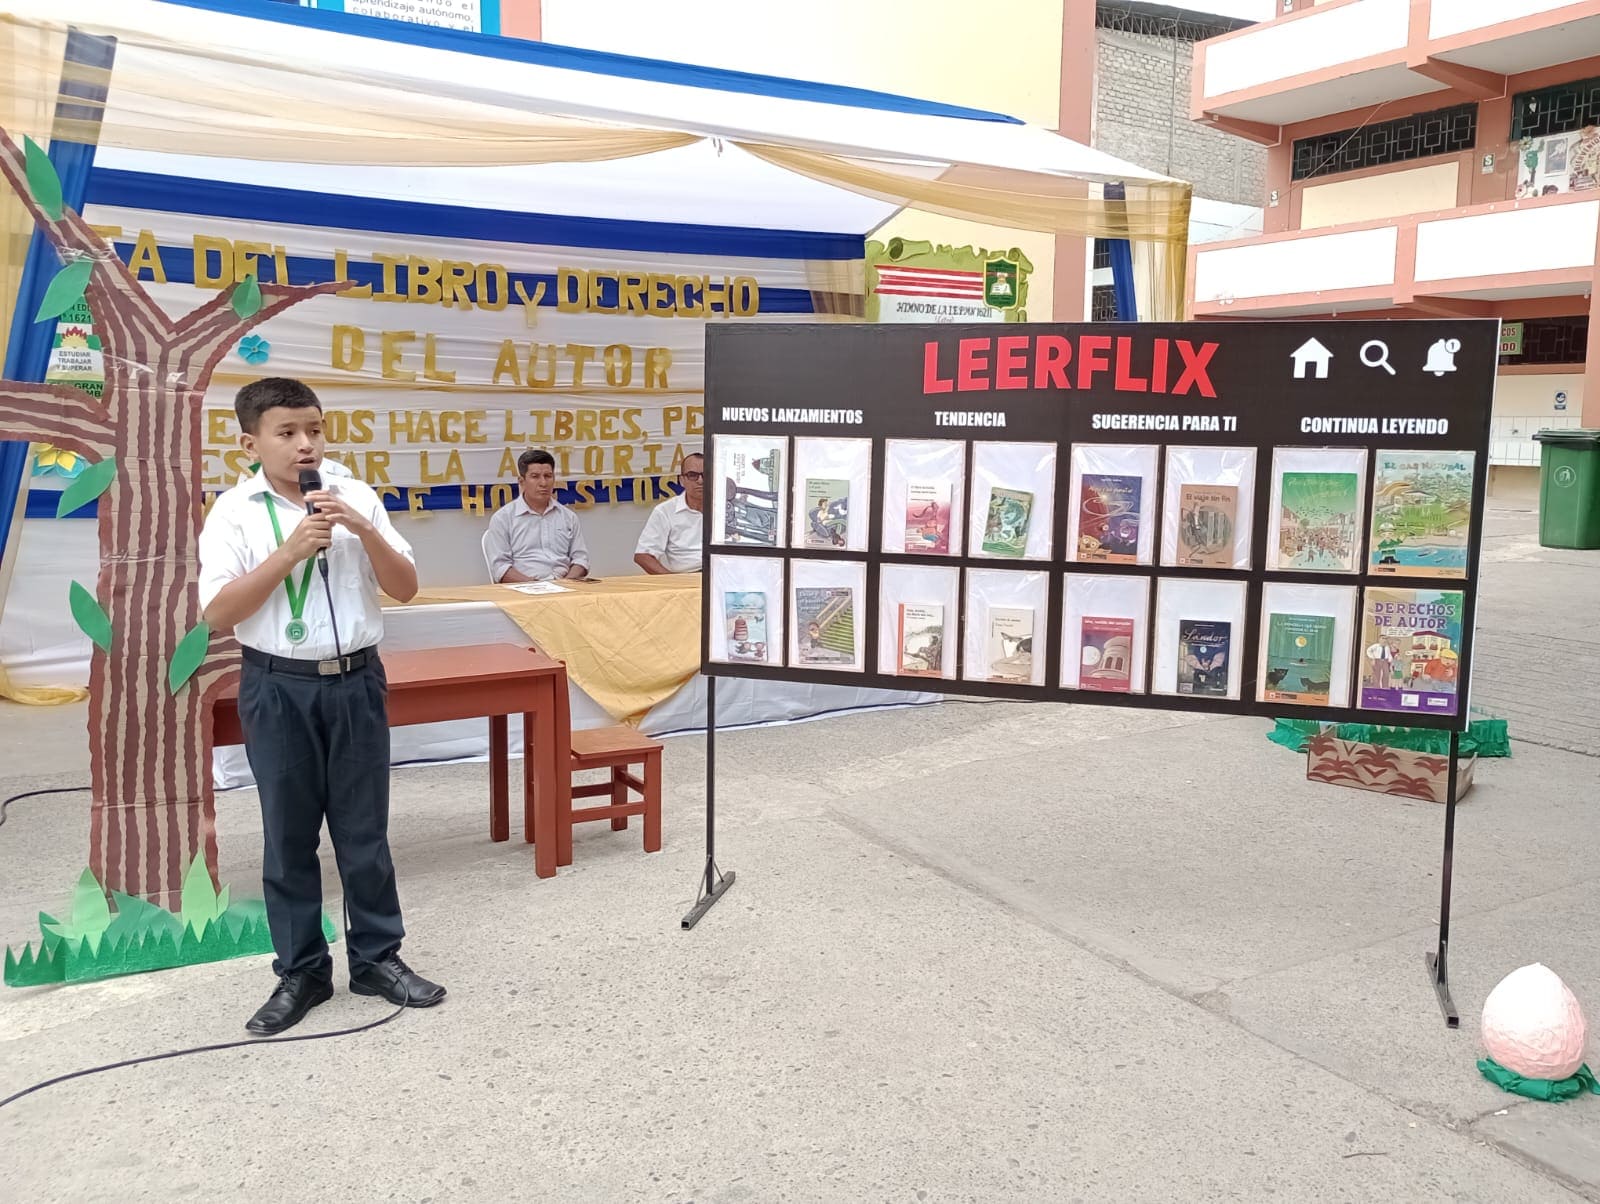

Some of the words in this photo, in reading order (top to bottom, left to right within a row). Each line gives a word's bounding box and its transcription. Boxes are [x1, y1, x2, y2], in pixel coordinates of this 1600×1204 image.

[334, 249, 508, 312] LIBRO
[557, 267, 759, 317] DERECHO
[331, 325, 456, 384] DEL
[492, 339, 673, 389] AUTOR
[923, 336, 1220, 398] LEERFLIX
[324, 410, 375, 444] OS
[389, 411, 488, 444] HACE
[504, 408, 648, 444] LIBRES,
[722, 407, 769, 422] NUEVOS
[771, 408, 863, 425] LANZAMIENTOS
[934, 411, 1006, 427] TENDENCIA
[1092, 414, 1180, 430] SUGERENCIA
[1182, 415, 1220, 431] PARA
[1222, 416, 1237, 432] TI
[1300, 416, 1379, 434] CONTINUA
[1381, 417, 1449, 435] LEYENDO
[420, 450, 475, 483] LA
[497, 443, 688, 478] ATORIA
[1374, 615, 1390, 627] DE
[1397, 617, 1447, 629] AUTOR
[1375, 602, 1456, 616] DERECHOS
